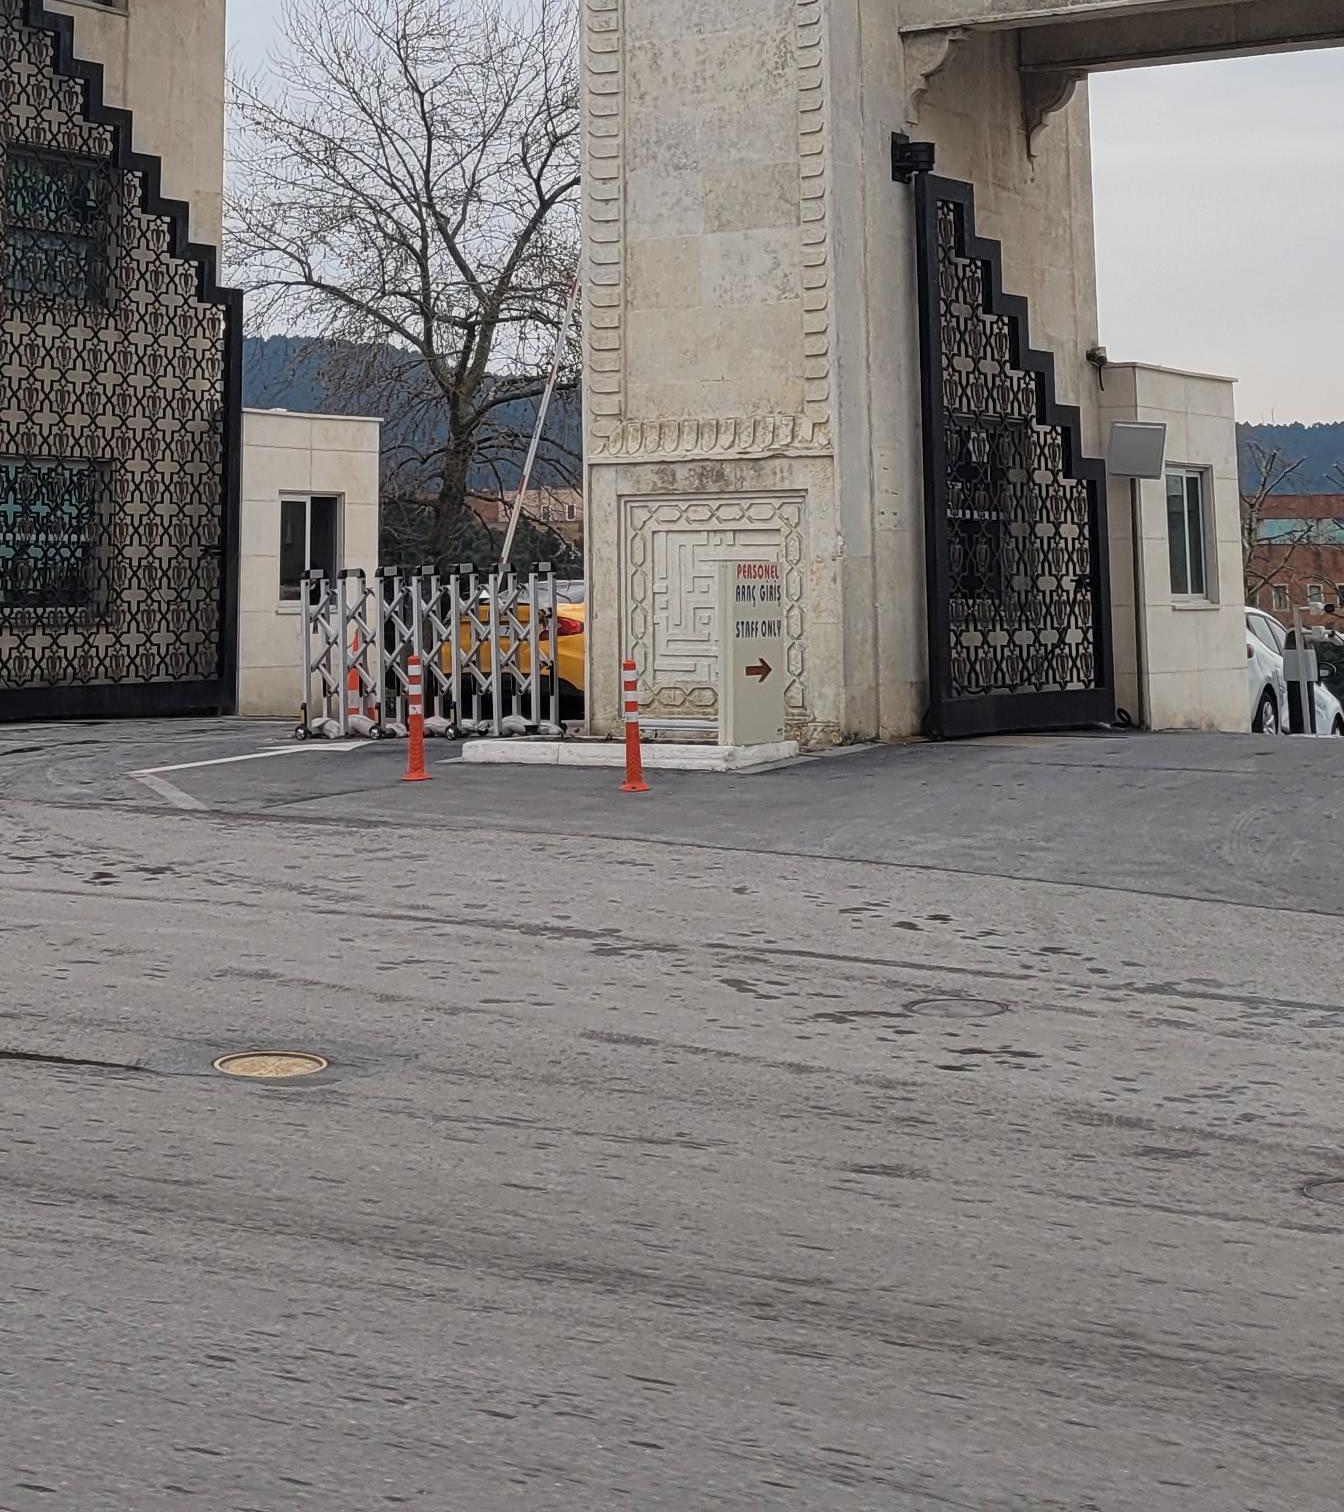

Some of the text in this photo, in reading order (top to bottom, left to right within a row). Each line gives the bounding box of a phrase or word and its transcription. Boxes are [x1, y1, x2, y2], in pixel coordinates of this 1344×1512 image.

[737, 563, 780, 580] PERSONEL
[736, 580, 782, 607] ARAÇ GİRİŞ
[736, 619, 782, 638] STAFF ONLY
